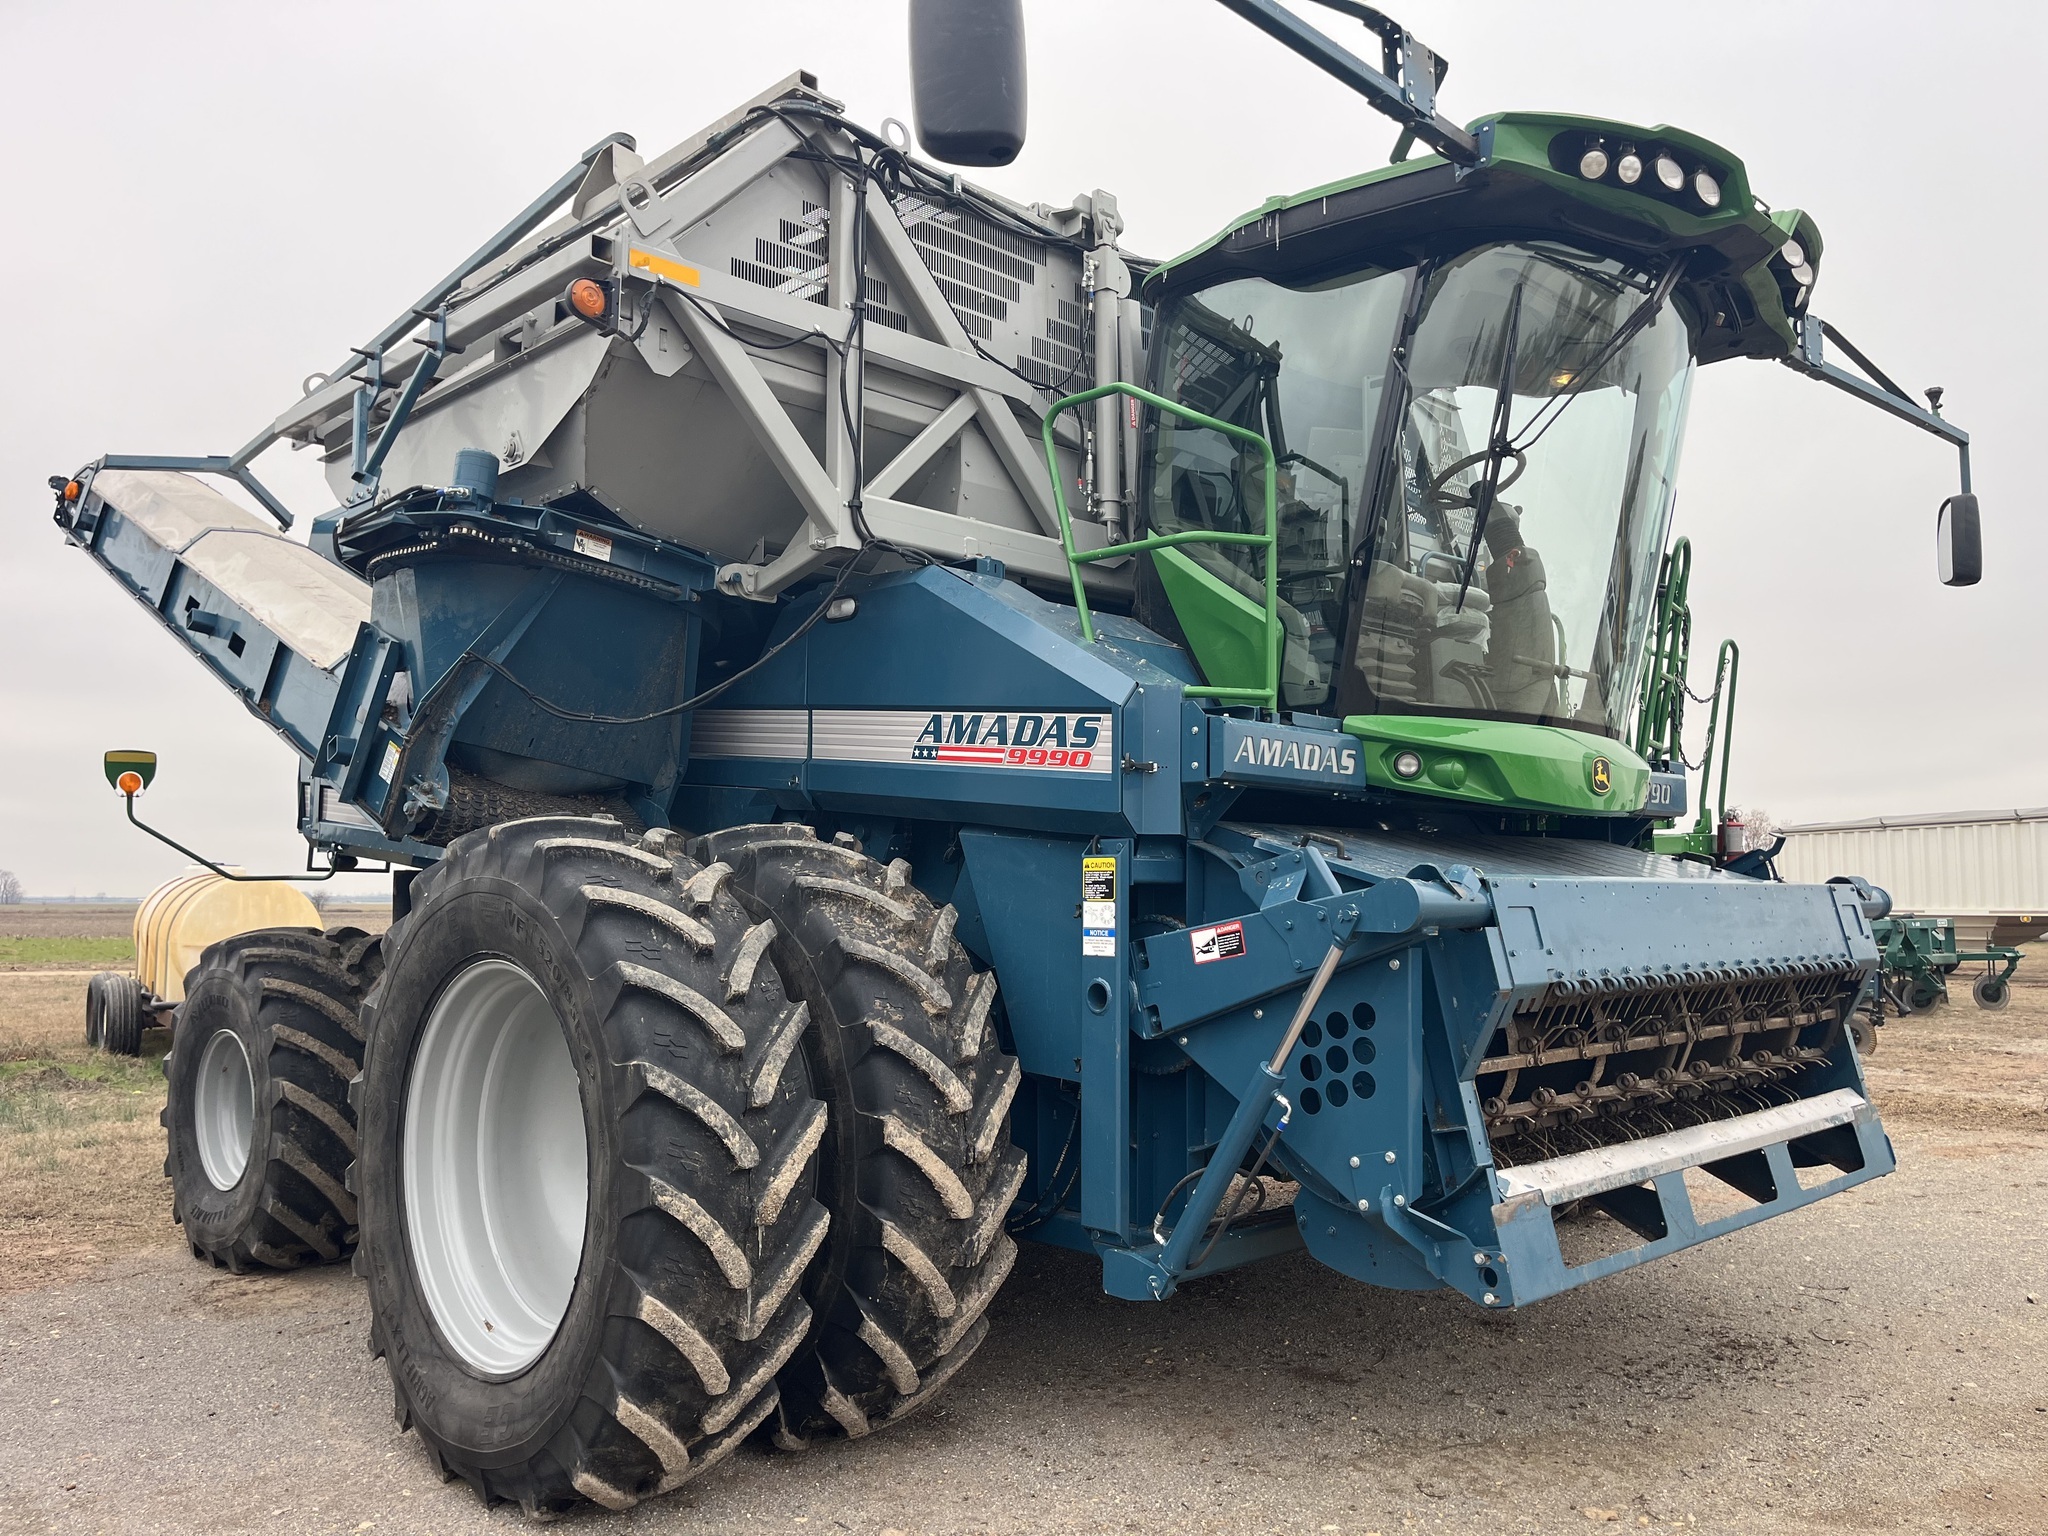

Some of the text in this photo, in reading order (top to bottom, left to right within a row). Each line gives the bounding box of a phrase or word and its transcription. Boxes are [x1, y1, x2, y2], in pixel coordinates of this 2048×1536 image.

[584, 533, 610, 545] WARNING
[916, 713, 1104, 749] AMADAS
[1005, 748, 1093, 768] 9990
[1234, 736, 1357, 776] AMADAS
[1645, 783, 1671, 805] 90
[1090, 861, 1115, 869] CAUTION
[1089, 929, 1109, 937] NOTICE
[1221, 923, 1239, 932] DANGER
